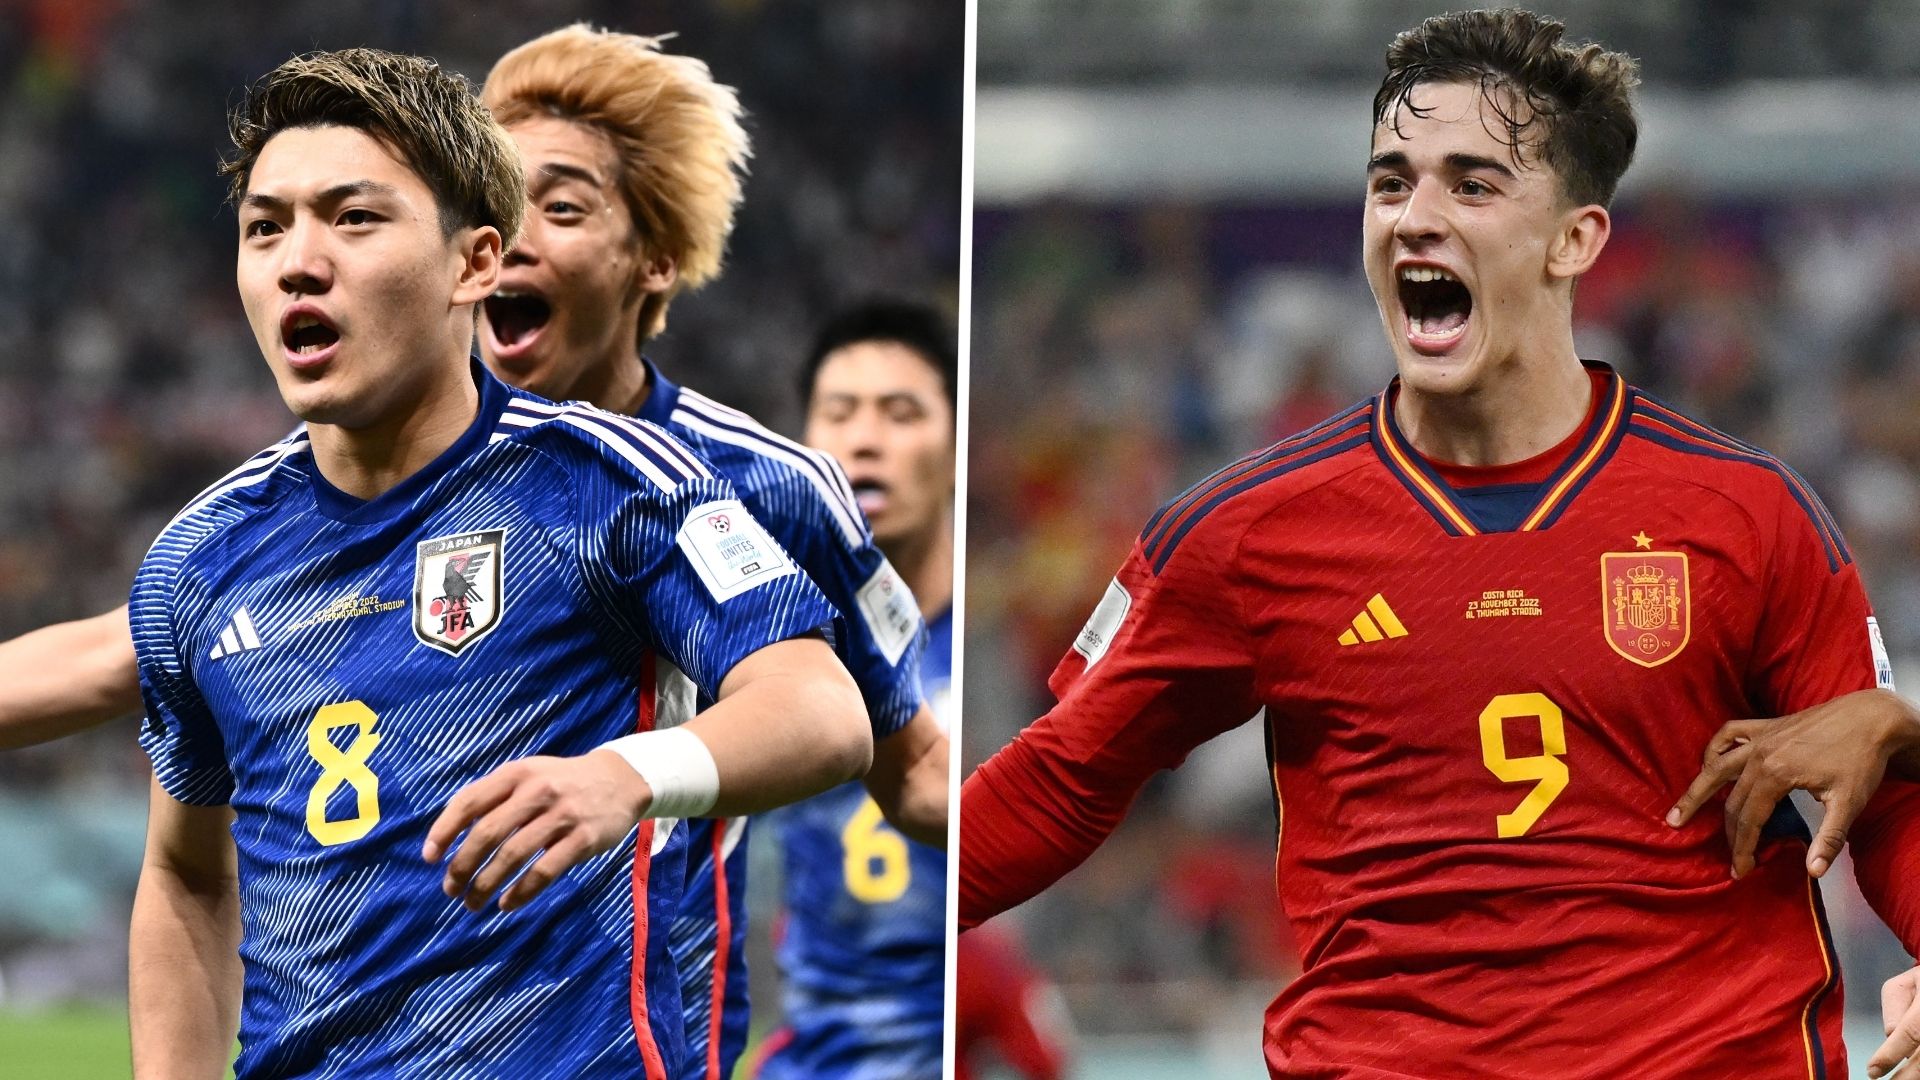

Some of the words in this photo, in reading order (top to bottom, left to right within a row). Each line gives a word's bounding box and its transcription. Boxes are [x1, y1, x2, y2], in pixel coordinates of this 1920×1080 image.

[438, 534, 483, 552] JAPAN
[720, 540, 755, 560] UNITES
[360, 595, 379, 608] 2022
[1468, 601, 1478, 610] 23
[1480, 599, 1518, 609] NOVEMBER
[1520, 598, 1539, 607] 2022
[1482, 590, 1505, 600] COSTA
[1506, 590, 1524, 599] RICA
[375, 599, 405, 613] STADIUM
[1465, 610, 1475, 619] AL
[1476, 607, 1510, 618] THUMAMA
[1511, 607, 1543, 616] STADIUM
[437, 611, 475, 634] JFA
[306, 699, 381, 848] 8
[1478, 692, 1570, 839] 9
[842, 794, 911, 904] 6
